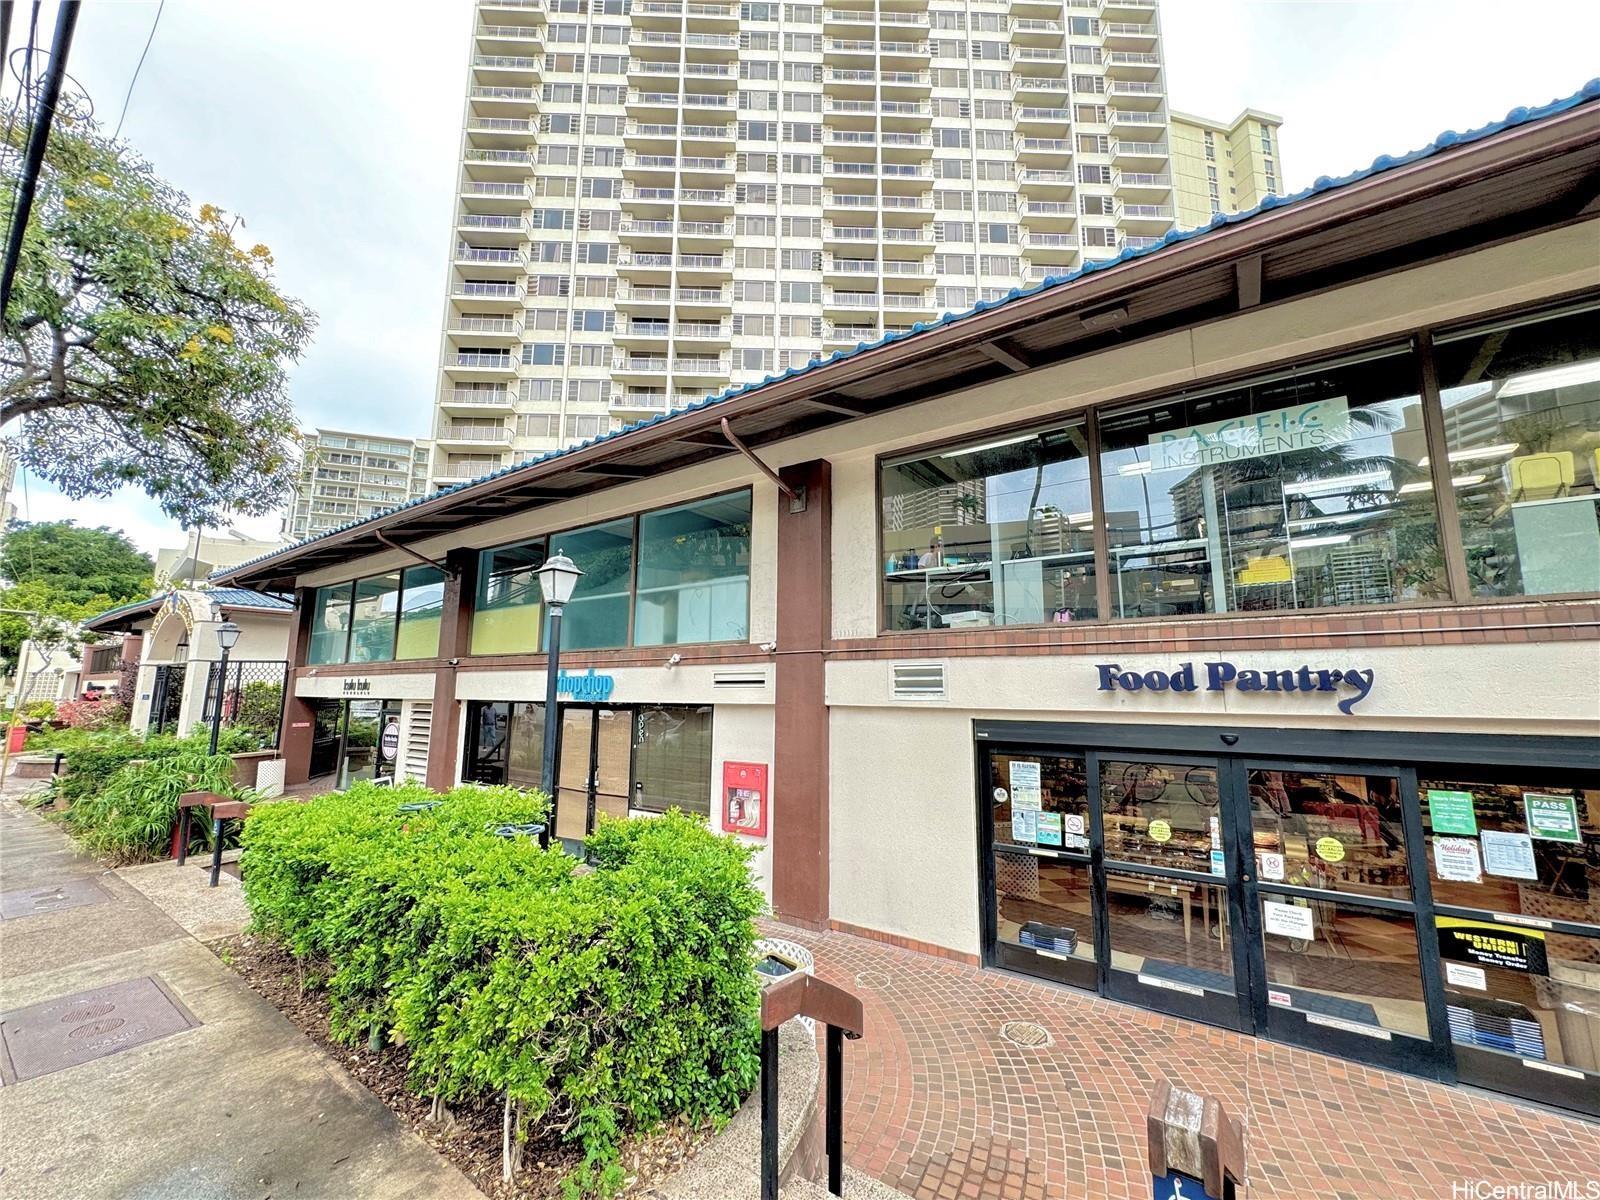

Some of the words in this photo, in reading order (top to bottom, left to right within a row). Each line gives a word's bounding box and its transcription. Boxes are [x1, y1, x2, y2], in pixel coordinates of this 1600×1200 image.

[1163, 428, 1326, 466] INSTRUMENTS
[1095, 662, 1199, 692] Food
[1204, 661, 1375, 716] Pantry
[1532, 800, 1567, 811] PASS
[1440, 843, 1472, 854] Holiday
[1453, 931, 1517, 948] WESTERN
[1473, 940, 1517, 955] UNION
[1467, 948, 1493, 958] Money
[1494, 952, 1527, 963] Transfer
[1478, 955, 1504, 966] Money
[1505, 960, 1528, 969] Order
